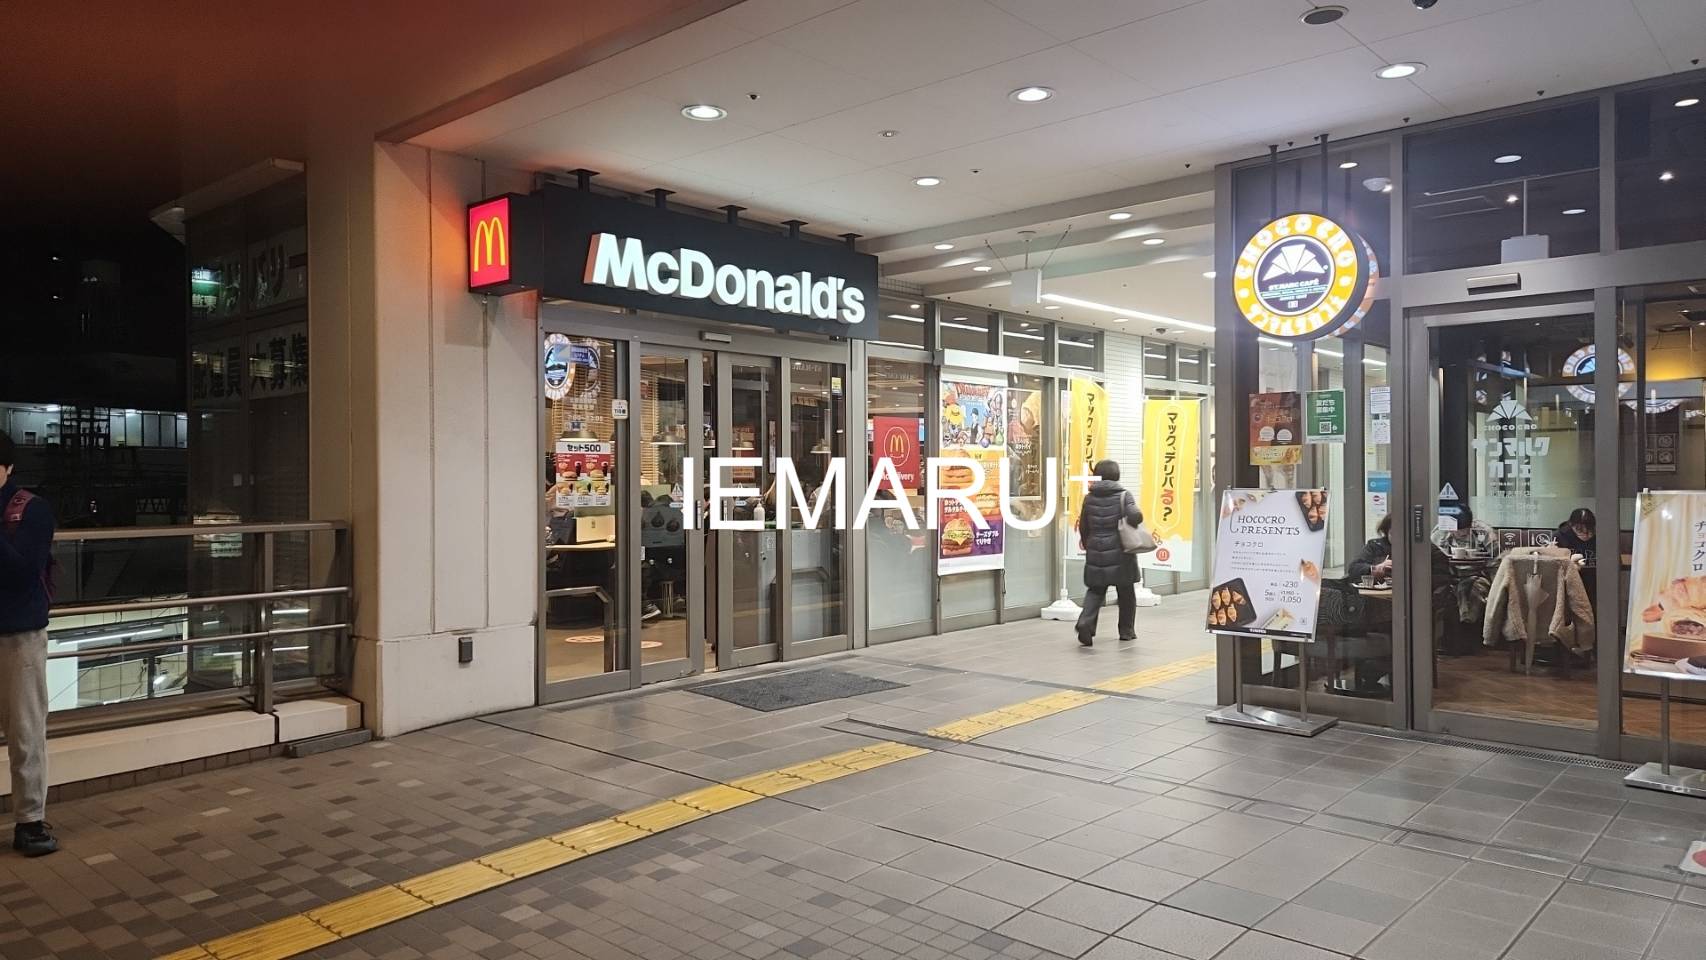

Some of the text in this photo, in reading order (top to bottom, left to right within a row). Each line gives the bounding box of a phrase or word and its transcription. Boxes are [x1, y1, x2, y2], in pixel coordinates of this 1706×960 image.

[590, 232, 867, 325] McDonald's
[566, 443, 602, 454] セット500
[1160, 412, 1178, 522] マック、デリバる?
[1487, 456, 1532, 479] カフェ
[1240, 525, 1301, 536] PRESENTS
[1234, 540, 1264, 548] チョコクロ
